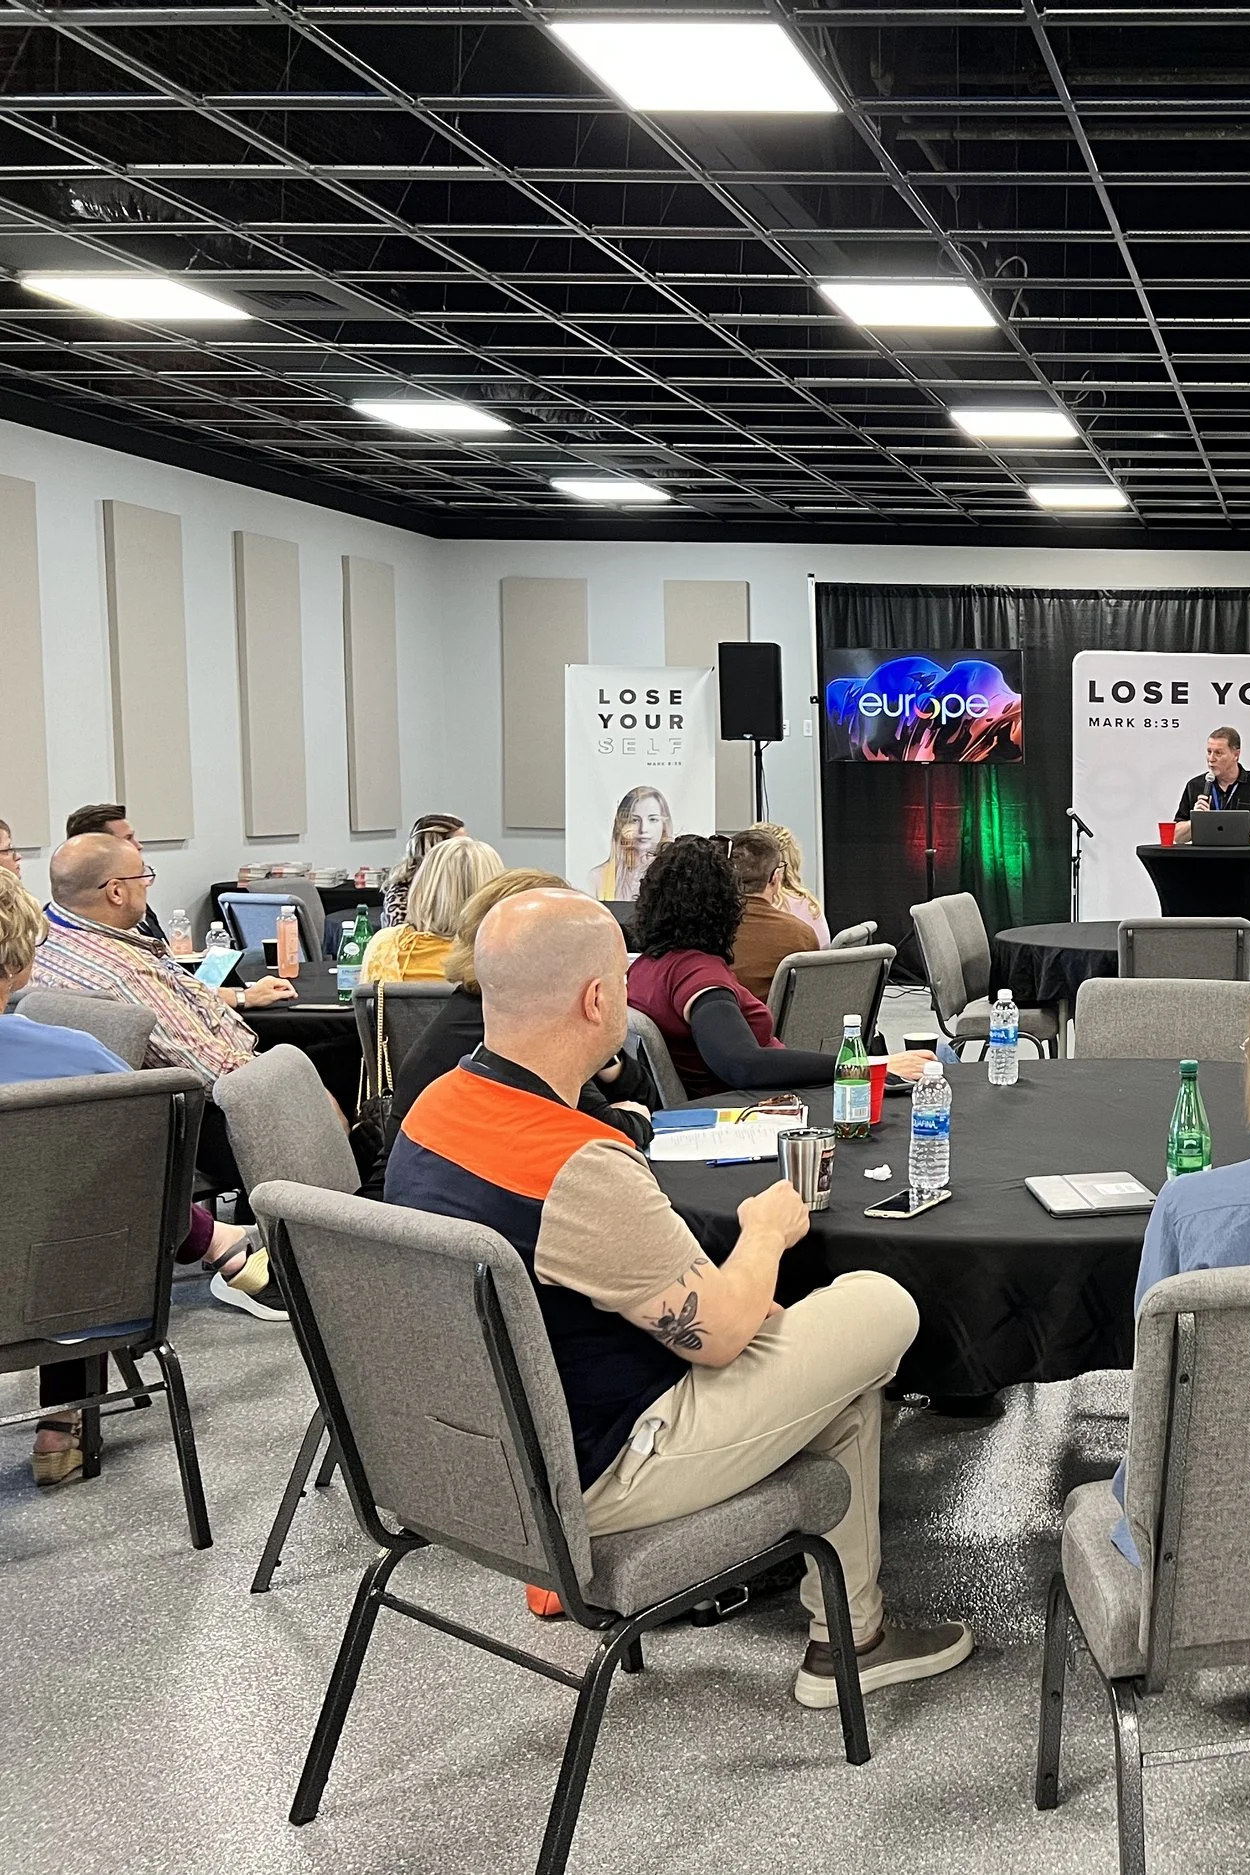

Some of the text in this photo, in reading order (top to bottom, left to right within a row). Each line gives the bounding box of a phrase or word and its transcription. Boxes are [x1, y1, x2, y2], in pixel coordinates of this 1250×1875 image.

[598, 688, 682, 705] LOSE
[1088, 680, 1189, 705] LOSE
[858, 692, 990, 725] europe
[597, 713, 684, 730] YOUR
[1088, 717, 1180, 729] MARK 8:35
[598, 737, 682, 755] SELF
